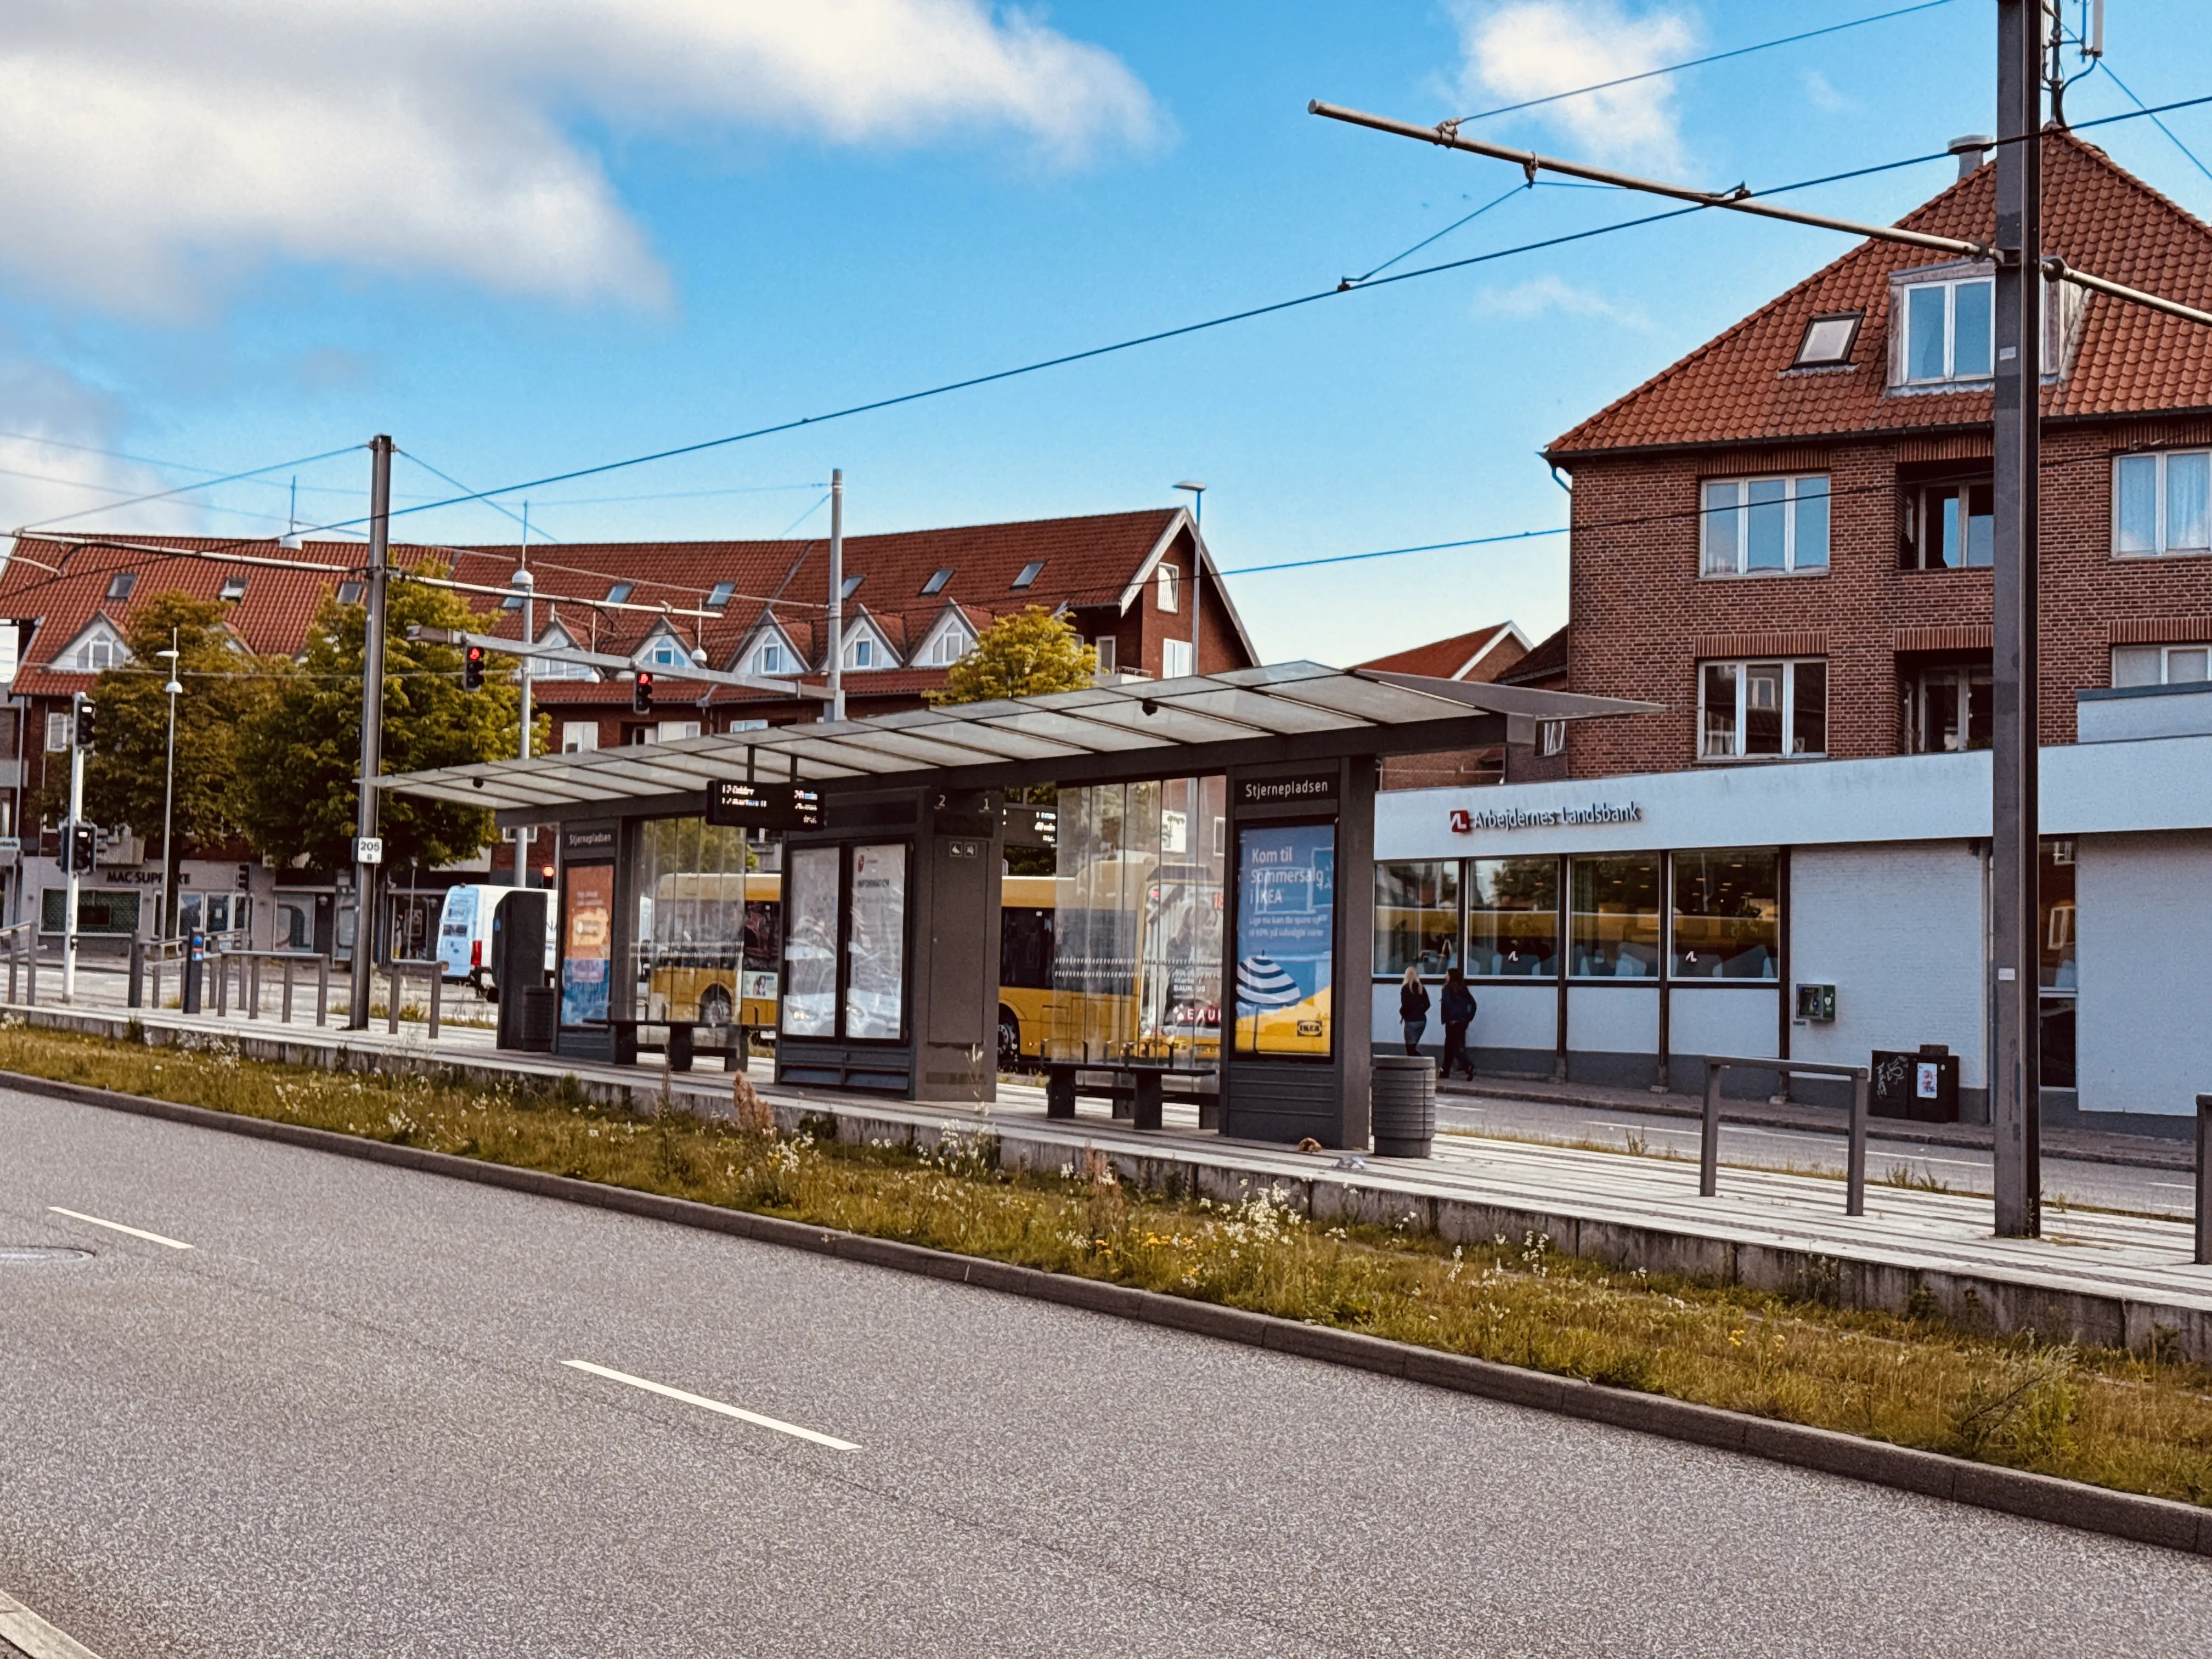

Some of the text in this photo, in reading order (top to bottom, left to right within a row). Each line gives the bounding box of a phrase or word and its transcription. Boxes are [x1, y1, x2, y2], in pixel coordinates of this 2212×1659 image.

[1245, 780, 1328, 800] Stjernepladsen
[939, 794, 946, 807] 2
[983, 798, 990, 810] 1
[1474, 808, 1556, 832] Arbejdernes
[1562, 801, 1640, 825] Landsbank
[569, 832, 612, 847] Stjernepladsen
[1251, 845, 1293, 864] Kom til
[107, 871, 132, 883] MAC
[1250, 868, 1324, 891] Sommersalg
